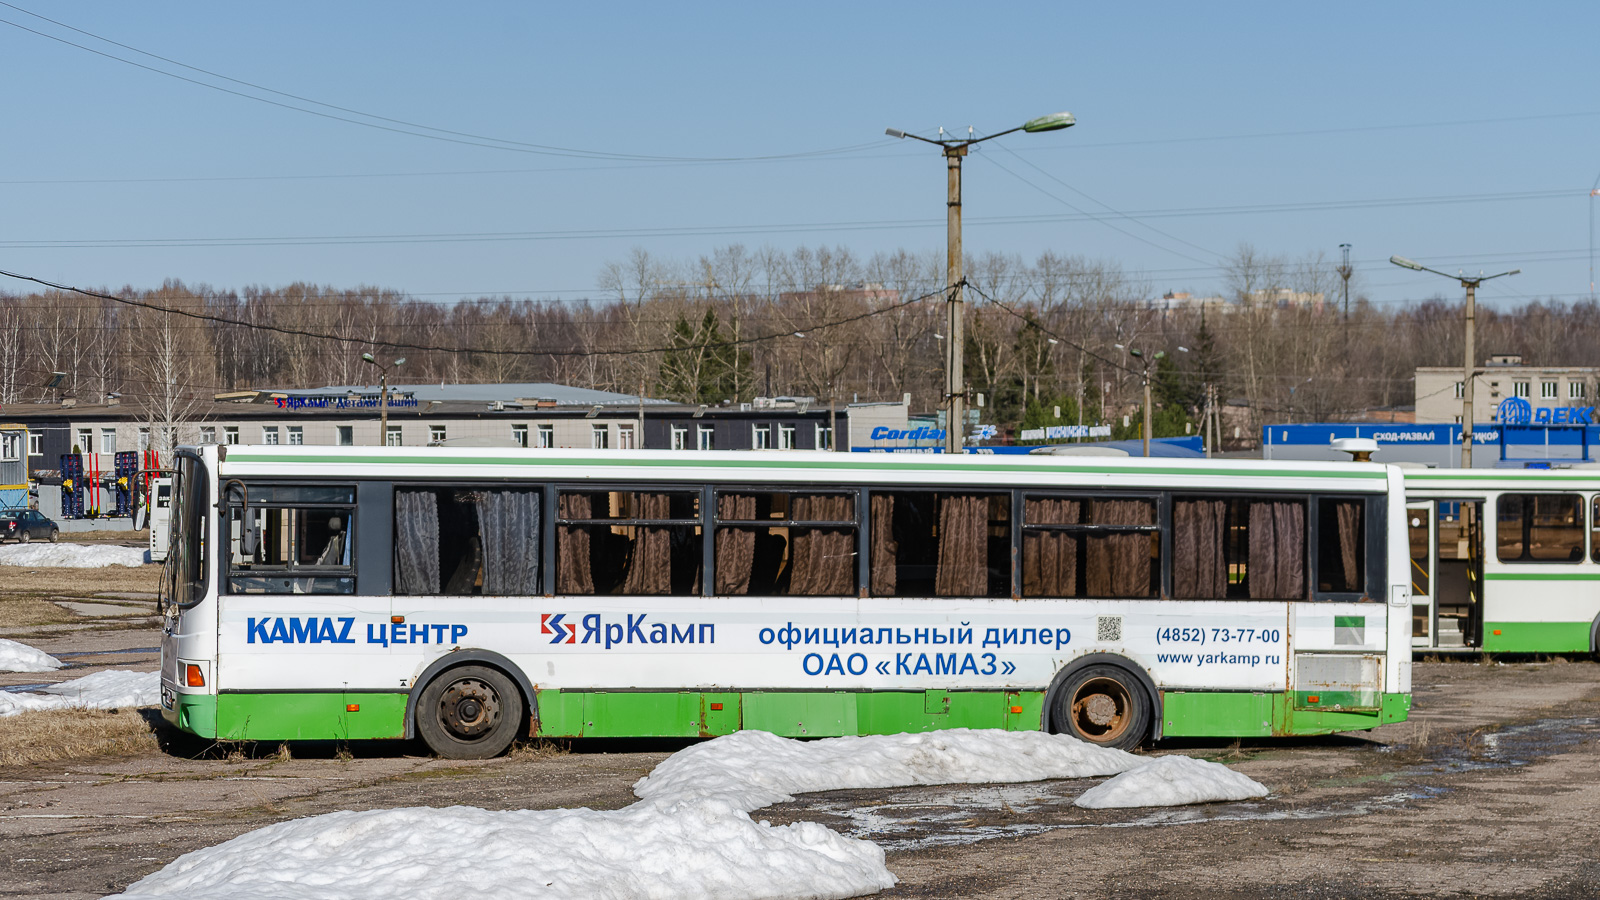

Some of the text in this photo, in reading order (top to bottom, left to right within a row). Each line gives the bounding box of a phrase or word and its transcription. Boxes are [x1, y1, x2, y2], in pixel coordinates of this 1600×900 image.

[367, 623, 468, 648] ЦЕНТР
[581, 613, 715, 649] ЯрКамп
[758, 621, 1072, 650] официальный дилер
[1156, 627, 1280, 646] (4852) 73-77-00
[802, 652, 1017, 675] ОАО «КАМАЗ»
